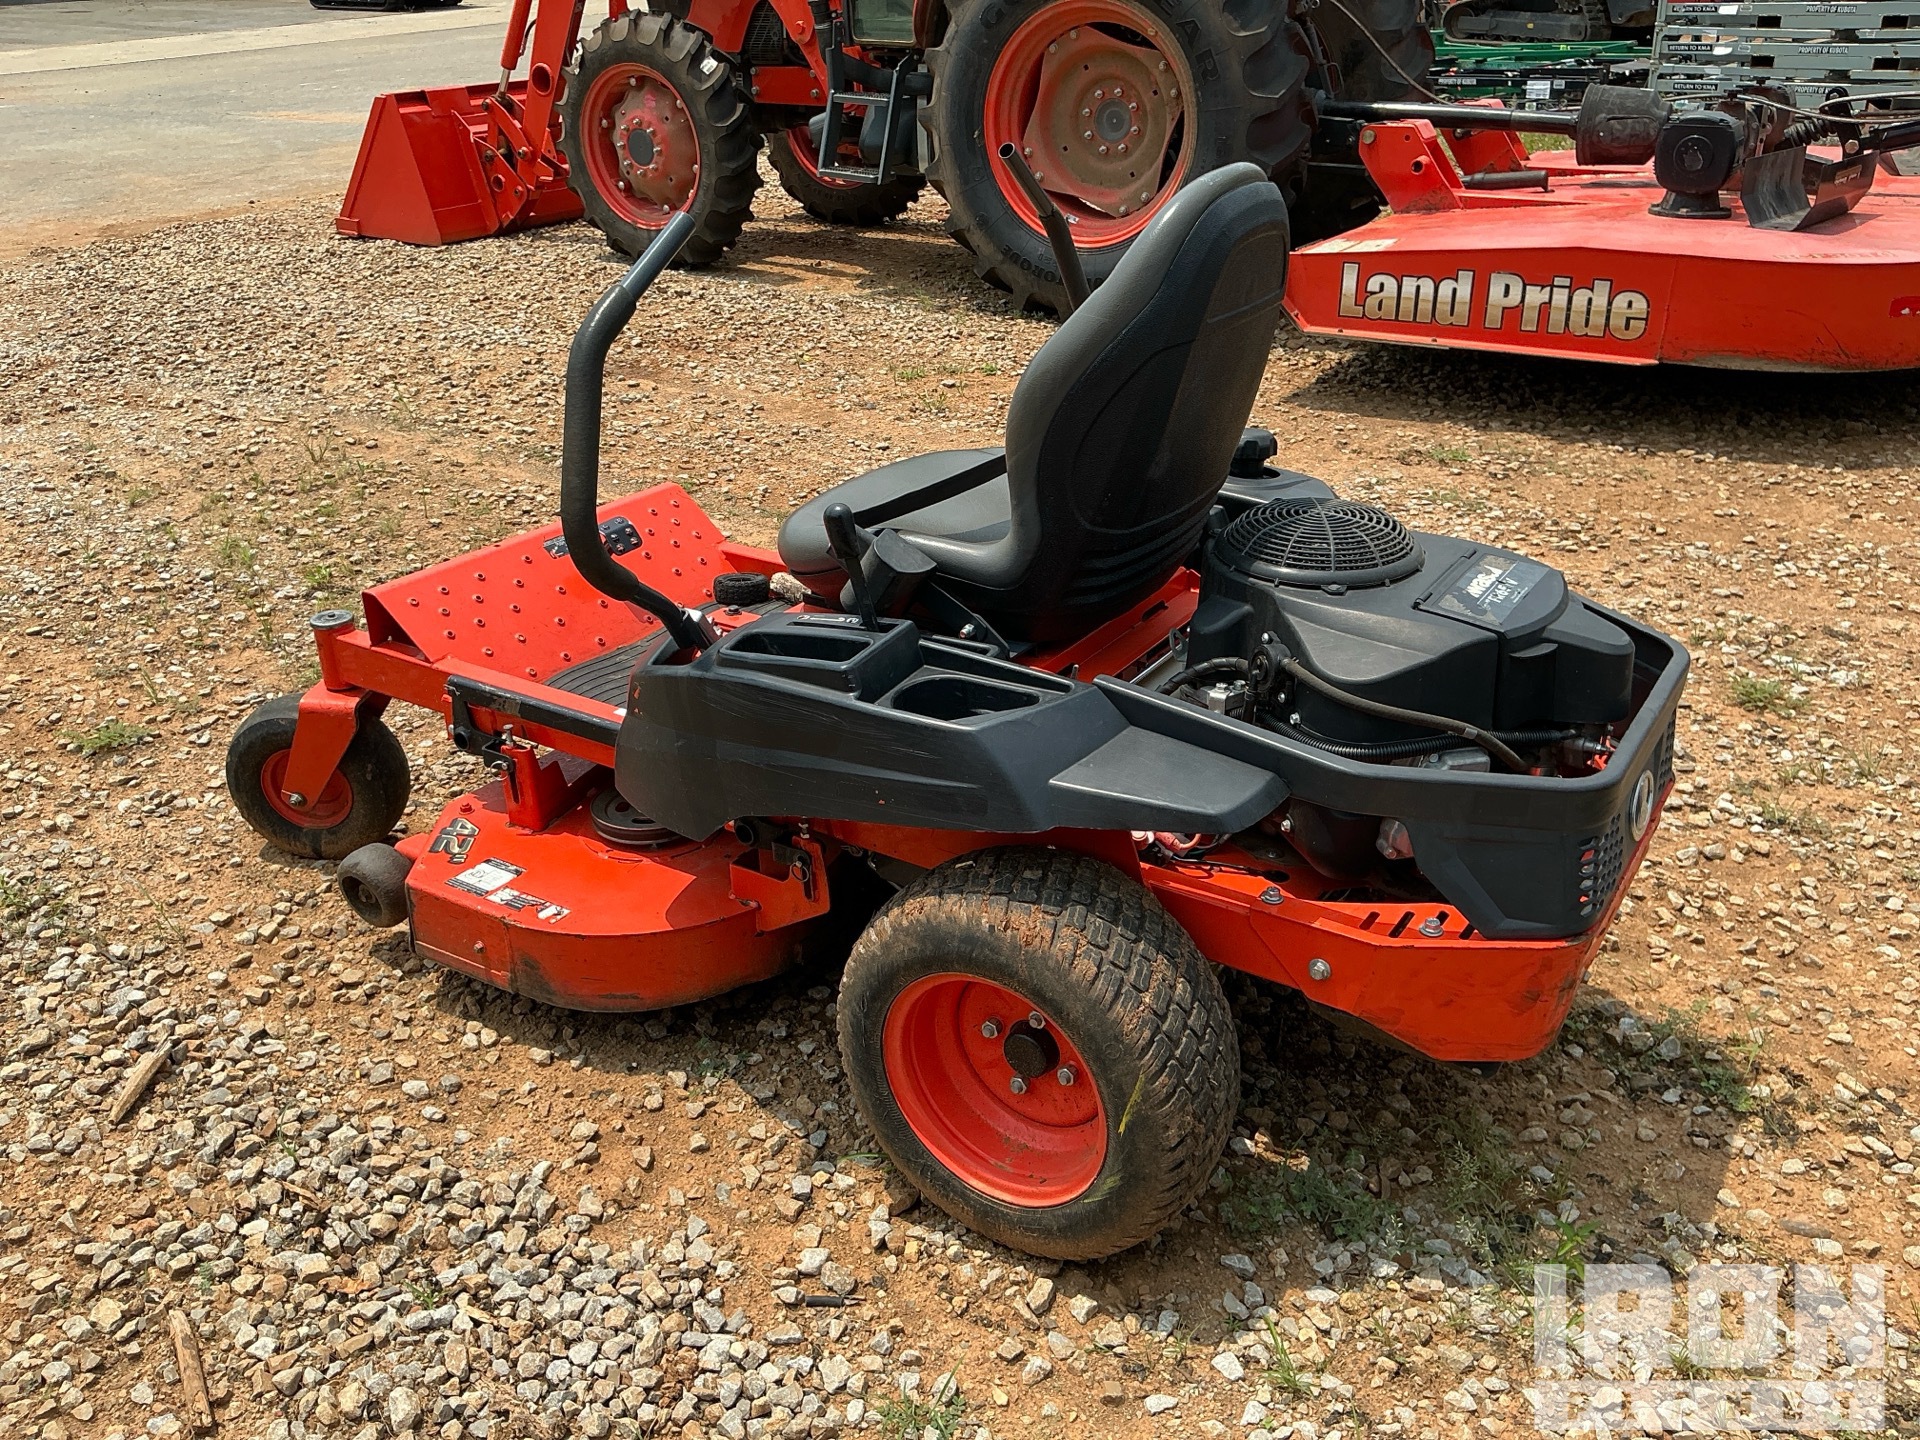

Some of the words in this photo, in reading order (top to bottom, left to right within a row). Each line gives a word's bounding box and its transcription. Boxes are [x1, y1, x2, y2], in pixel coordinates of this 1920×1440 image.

[1806, 5, 1830, 13] PROPERTY
[1798, 46, 1822, 54] PROPERTY
[1822, 46, 1829, 54] OF
[1818, 86, 1825, 94] OF
[1338, 261, 1475, 328] Land
[1484, 270, 1650, 341] Pride
